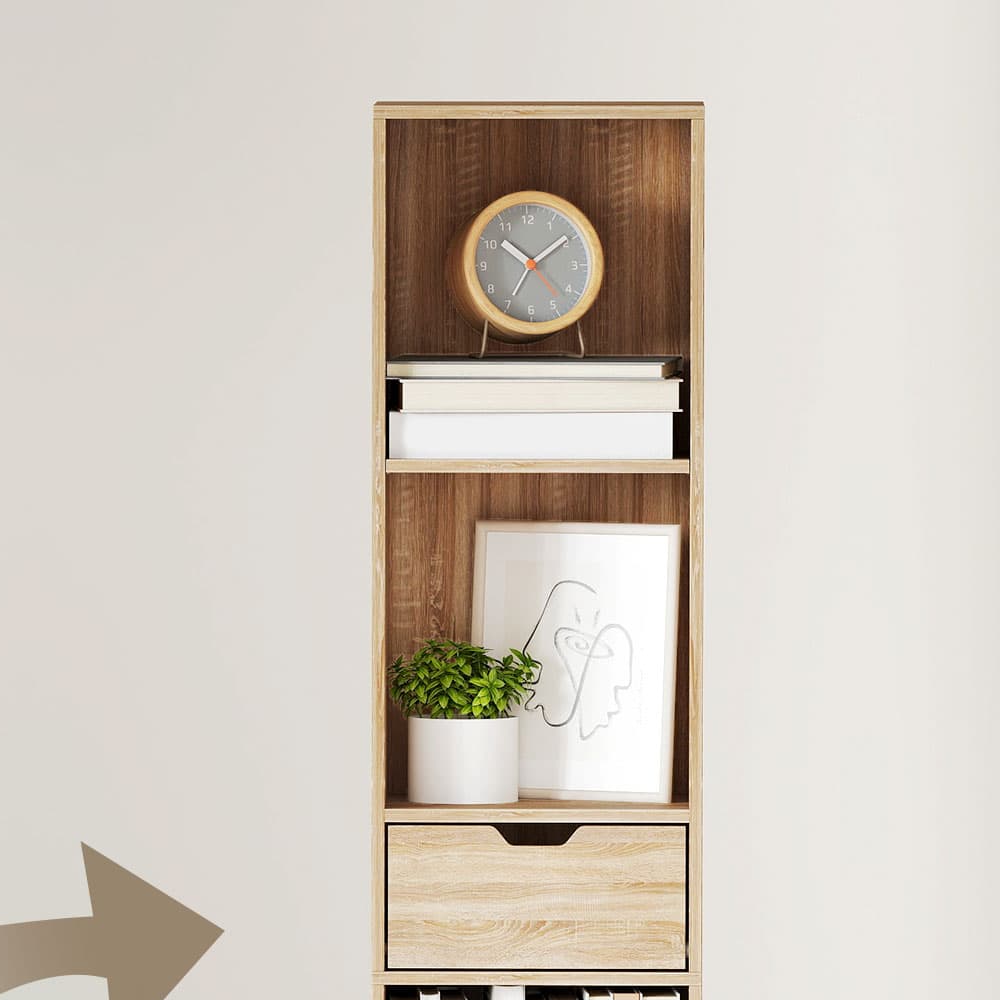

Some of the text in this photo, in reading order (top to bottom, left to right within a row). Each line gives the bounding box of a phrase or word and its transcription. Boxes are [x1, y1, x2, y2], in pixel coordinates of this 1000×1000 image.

[521, 216, 534, 225] 12
[499, 223, 511, 231] 11
[547, 222, 551, 231] 1
[485, 240, 496, 249] 10
[480, 261, 486, 271] 9
[571, 261, 577, 270] 3
[488, 285, 494, 293] 8
[505, 300, 511, 308] 7
[550, 301, 556, 309] 5
[528, 306, 534, 314] 6
